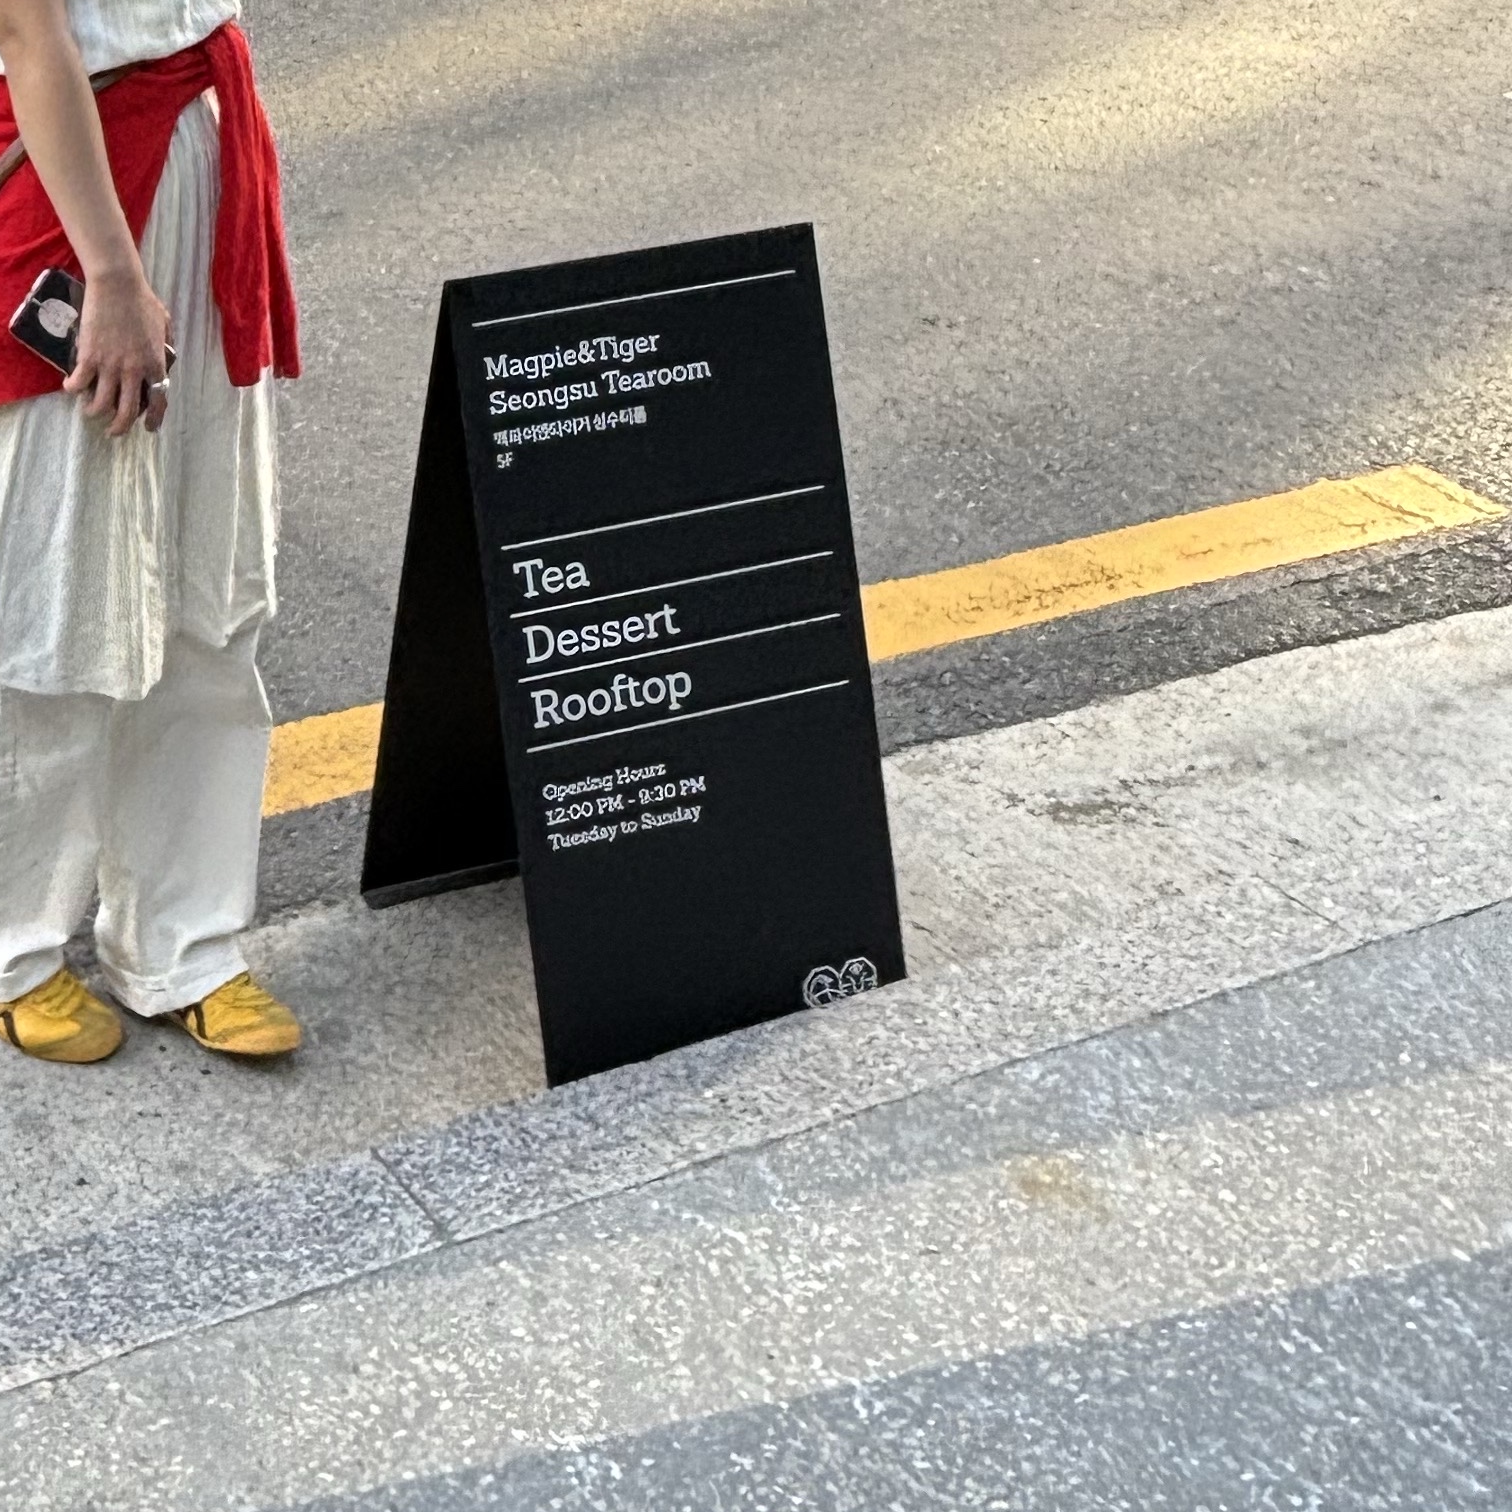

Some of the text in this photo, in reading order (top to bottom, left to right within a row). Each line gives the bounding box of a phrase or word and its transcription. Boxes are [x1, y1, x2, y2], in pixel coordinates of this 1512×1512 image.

[483, 334, 660, 380] Magpie&Tiger
[489, 360, 712, 415] Seongsu Tearoom
[513, 558, 591, 598] Tea
[522, 603, 681, 664] Dessert
[530, 672, 692, 729] Rooftop
[542, 764, 667, 802] Opening Hours
[545, 801, 594, 826] 12:00
[596, 794, 624, 815] PM
[680, 776, 707, 796] PM
[547, 805, 702, 851] Tuesday to Sunday
